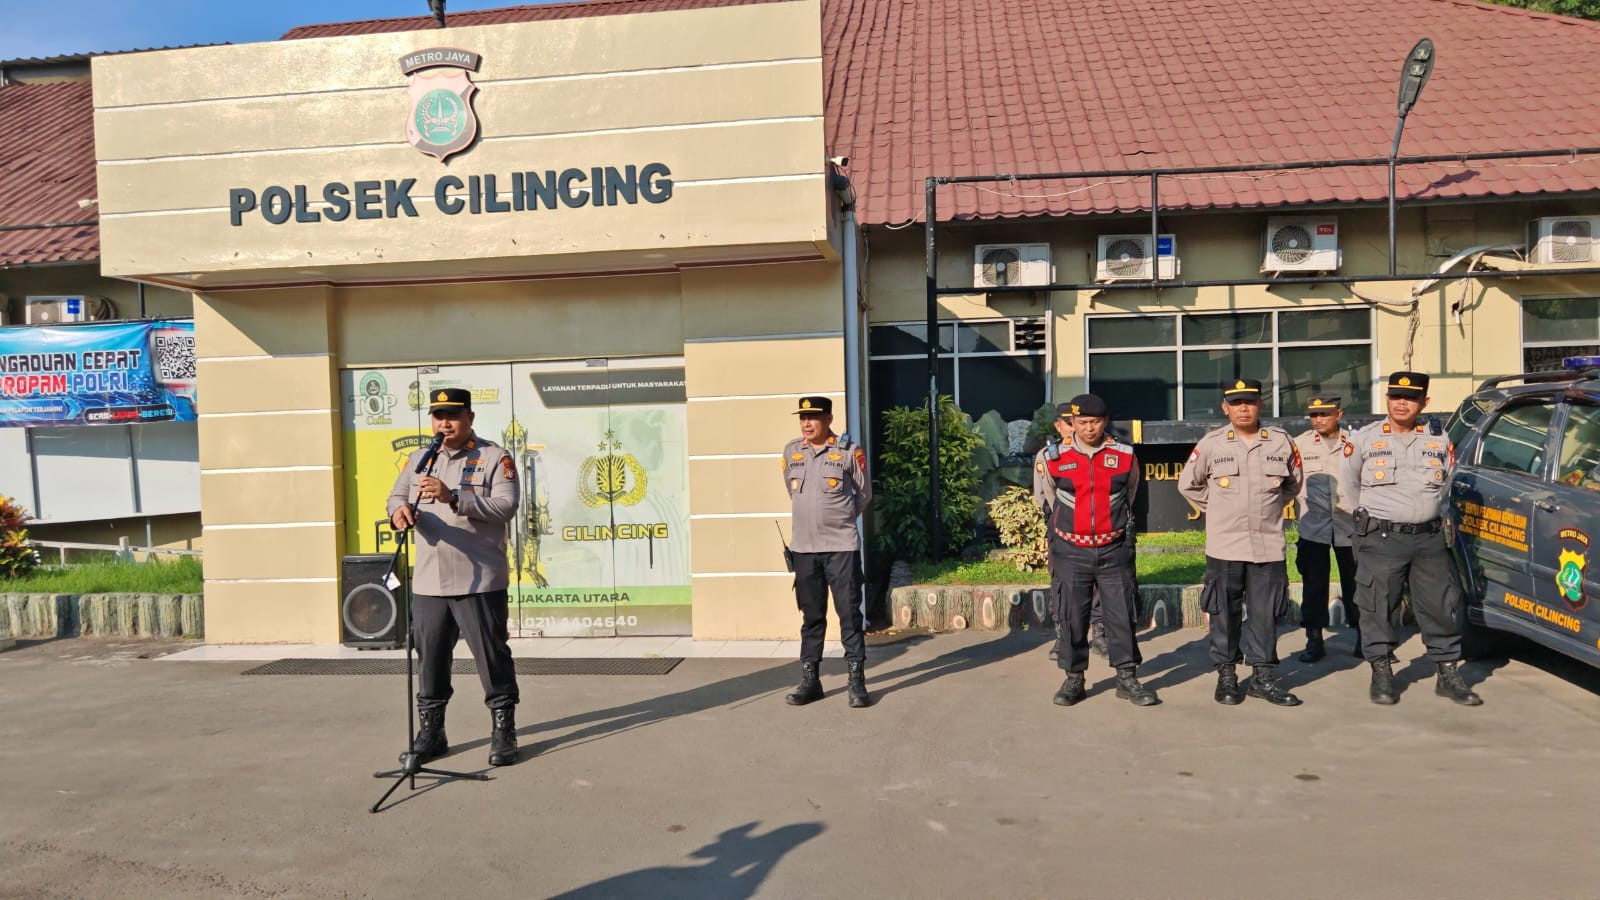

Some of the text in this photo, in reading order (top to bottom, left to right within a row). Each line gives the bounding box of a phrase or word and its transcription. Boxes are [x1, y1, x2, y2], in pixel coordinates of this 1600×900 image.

[405, 51, 471, 69] METRO JAYA
[229, 162, 674, 226] POLSEK CILINCING
[83, 350, 141, 370] CEPAT
[72, 372, 128, 393] POLRI
[577, 383, 612, 391] TERPADU
[348, 394, 398, 416] TOP
[395, 437, 419, 449] METRO
[562, 523, 669, 542] CILINCING
[1489, 522, 1526, 542] CILINCING
[1560, 529, 1589, 545] METRO JAYA
[517, 593, 580, 604] JAKARTA
[583, 592, 630, 603] UTARA
[559, 615, 638, 629] 4404640
[1504, 592, 1581, 633] POLSEK CILINCING
